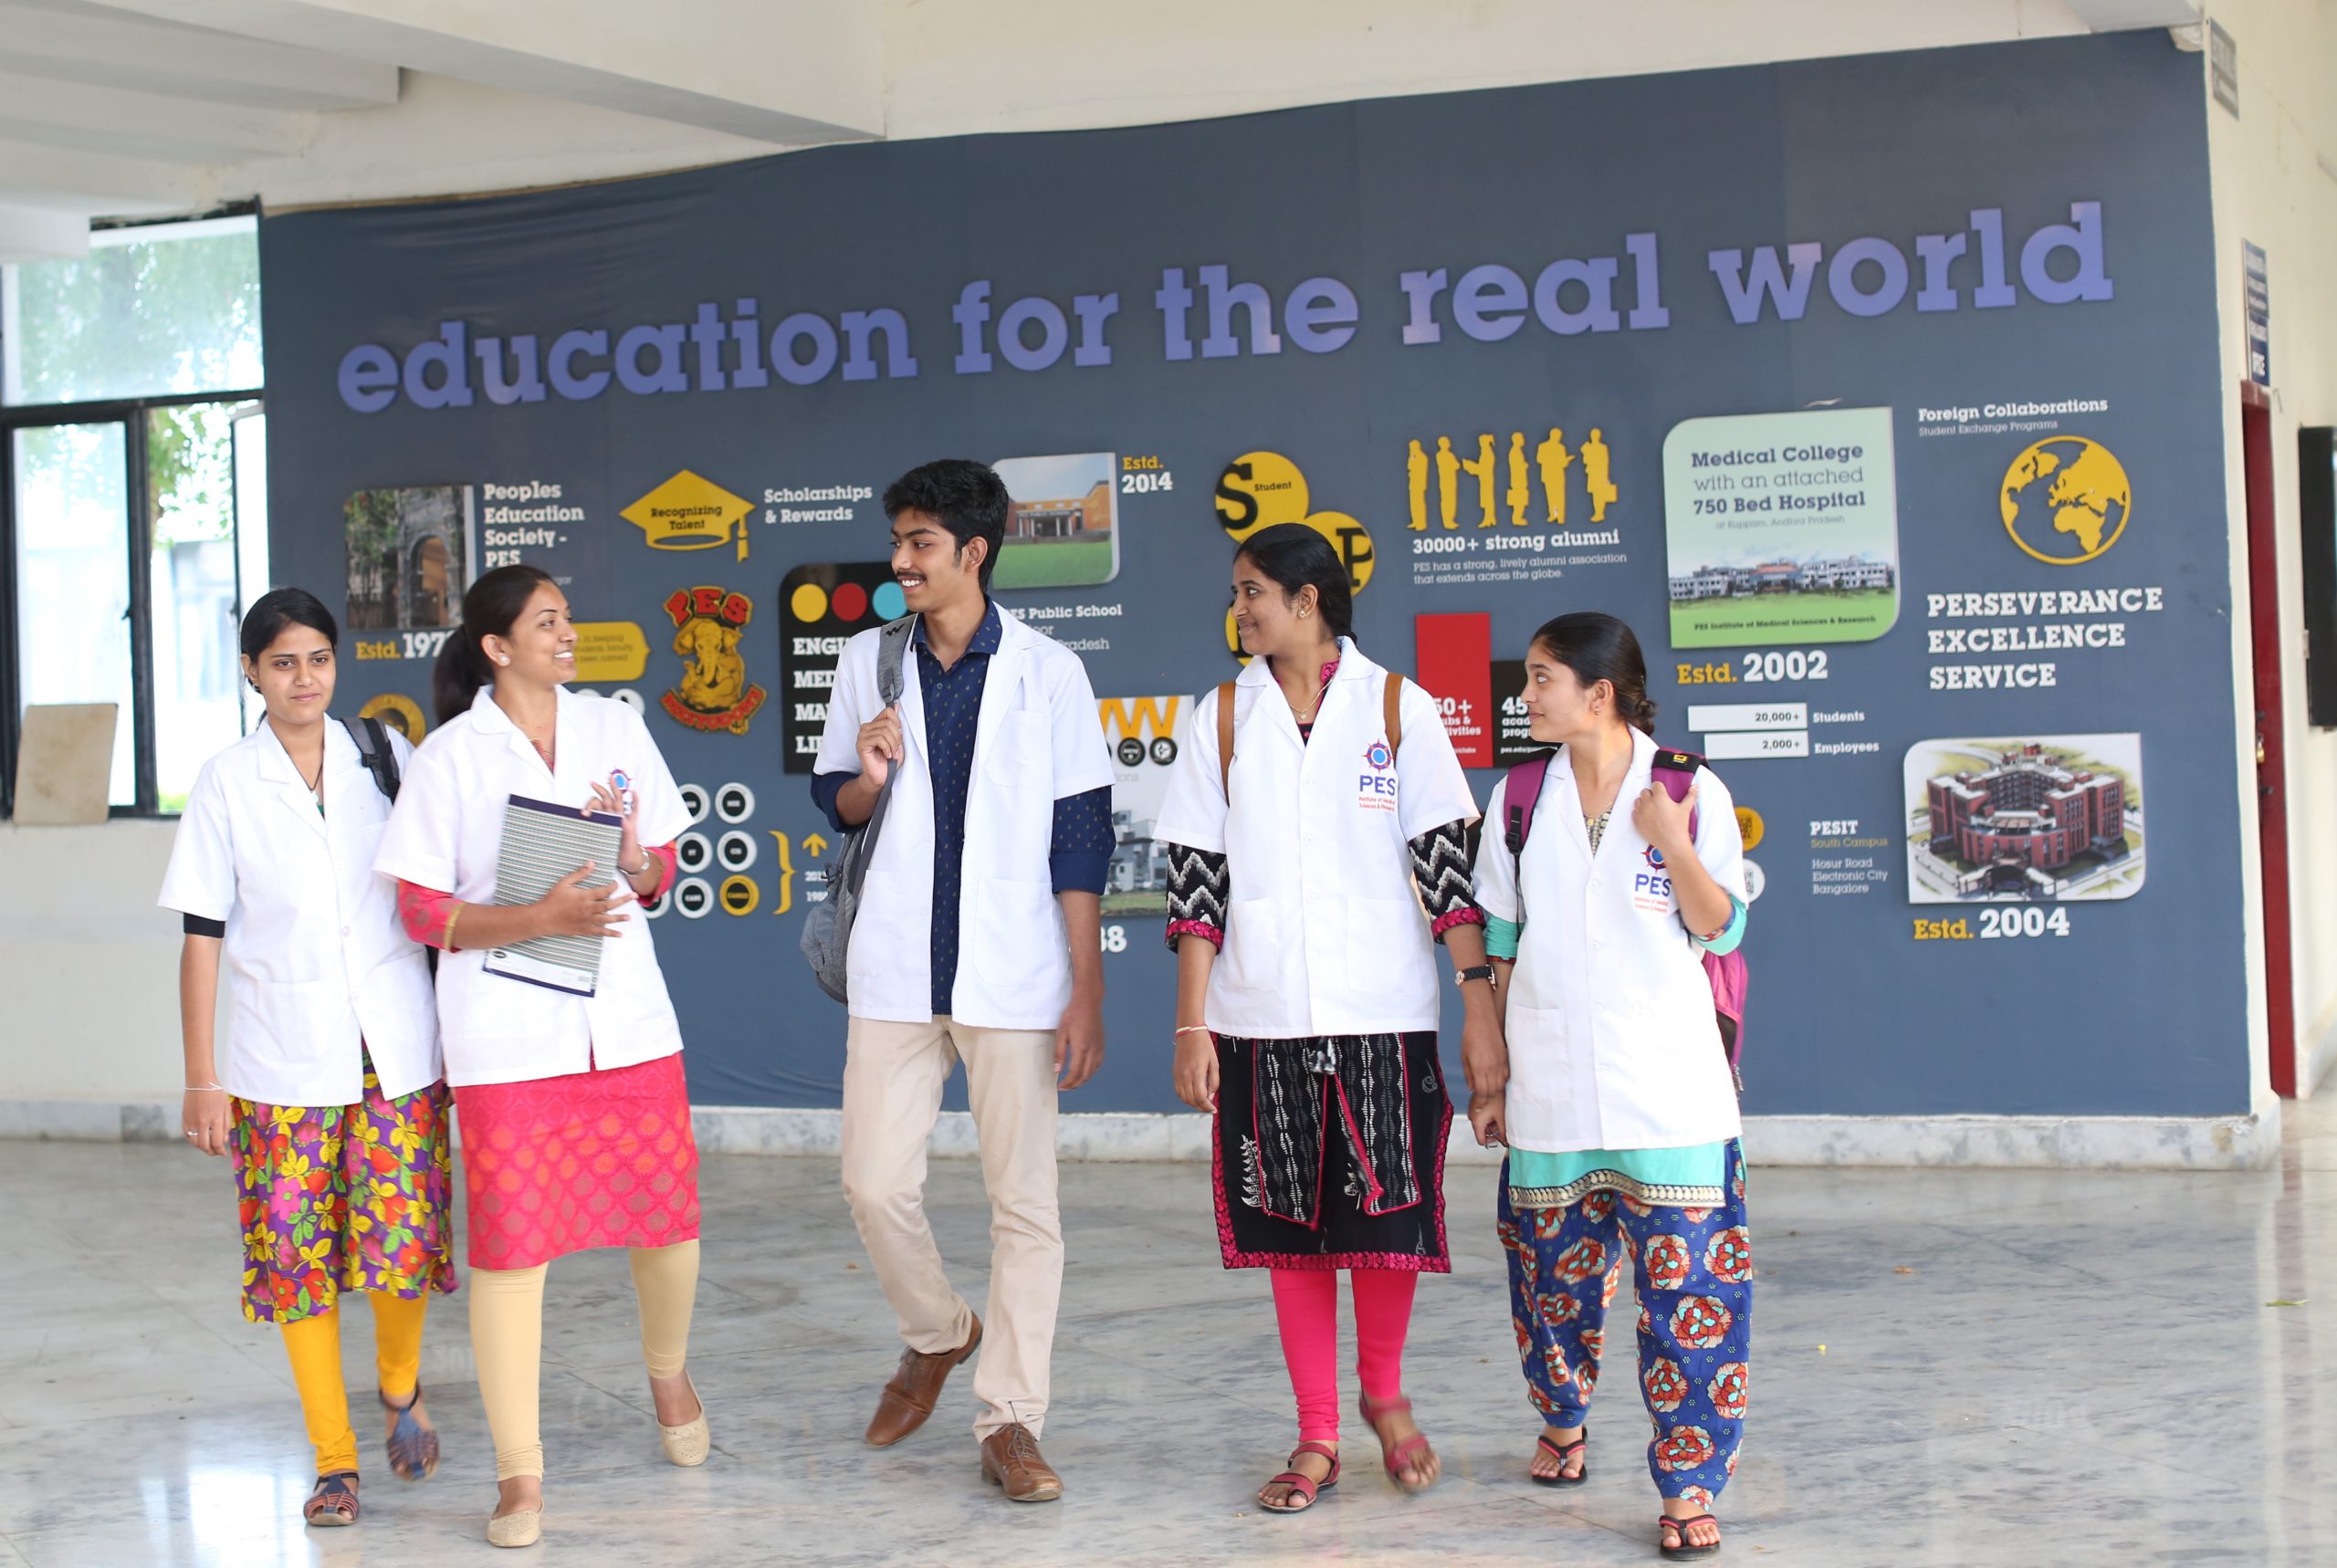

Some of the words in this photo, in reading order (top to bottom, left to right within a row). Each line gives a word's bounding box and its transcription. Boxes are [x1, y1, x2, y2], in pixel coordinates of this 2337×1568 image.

[338, 298, 917, 413] education
[953, 279, 1119, 373] for
[1155, 265, 1358, 361] the
[1400, 233, 1670, 344] real
[1708, 201, 2113, 324] world
[1918, 407, 1980, 423] Foreign
[1984, 399, 2109, 418] Collaborations
[1919, 425, 1956, 436] Student
[1958, 423, 2008, 434] Exchange
[2010, 420, 2058, 432] Programs
[1123, 455, 1164, 471] Estd.
[1691, 448, 1776, 467] Medical
[1783, 444, 1864, 464] College
[1122, 472, 1173, 494] 2014
[1253, 481, 1292, 491] Student
[1694, 474, 1734, 492] with
[1741, 477, 1768, 489] an
[1774, 466, 1864, 487] attached
[484, 480, 561, 503] Peoples
[764, 485, 873, 503] Scholarships
[1215, 462, 1259, 530] S
[651, 506, 722, 518] Recognizing
[1693, 498, 1727, 515] 750
[1734, 496, 1773, 513] Bed
[1779, 491, 1866, 511] Hospital
[484, 505, 585, 524] Education
[765, 510, 777, 524] &
[781, 507, 854, 523] Rewards
[1770, 517, 1806, 527] Andhra
[1808, 515, 1845, 526] Pradesh
[669, 519, 705, 530] Talent
[485, 527, 556, 548] Society
[1413, 536, 1479, 554] 30000+
[1485, 534, 1546, 552] strong
[1551, 528, 1619, 548] alumni
[485, 549, 520, 568] PES
[1414, 562, 1430, 572] PES
[1433, 562, 1451, 571] has
[1453, 562, 1461, 570] a
[1500, 558, 1527, 569] lively
[1529, 555, 1567, 566] alumni
[1568, 553, 1627, 565] association
[1414, 575, 1434, 584] that
[1436, 572, 1475, 583] extends
[1477, 571, 1510, 581] across
[1513, 570, 1529, 580] the
[1531, 569, 1564, 580] globe.
[664, 585, 753, 628] PES
[1029, 606, 1073, 620] Public
[1075, 603, 1123, 618] School
[1927, 587, 2164, 617] PERSEVERANCE
[355, 641, 401, 659] Estd.
[403, 630, 456, 659] 197
[1928, 623, 2126, 653] EXCELLENCE
[1677, 662, 1737, 685] Estd.
[1743, 650, 1829, 683] 2002
[1930, 663, 2057, 690] SERVICE
[1755, 711, 1799, 723] 20,000+
[1813, 710, 1865, 723] Students
[1763, 739, 1800, 750] 2,000+
[1814, 742, 1880, 756] Employees
[1359, 775, 1396, 797] PES
[1809, 820, 1859, 836] PESIT
[1811, 837, 1841, 849] South
[1843, 837, 1889, 849] Campus
[1811, 858, 1842, 870] Hosur
[1844, 857, 1873, 869] Road
[1635, 873, 1672, 897] PES
[1812, 870, 1865, 883] Electronic
[1867, 869, 1888, 883] City
[1813, 883, 1870, 895] Bangalore
[1913, 918, 1974, 940] Estd.
[1979, 907, 2070, 938] 2004
